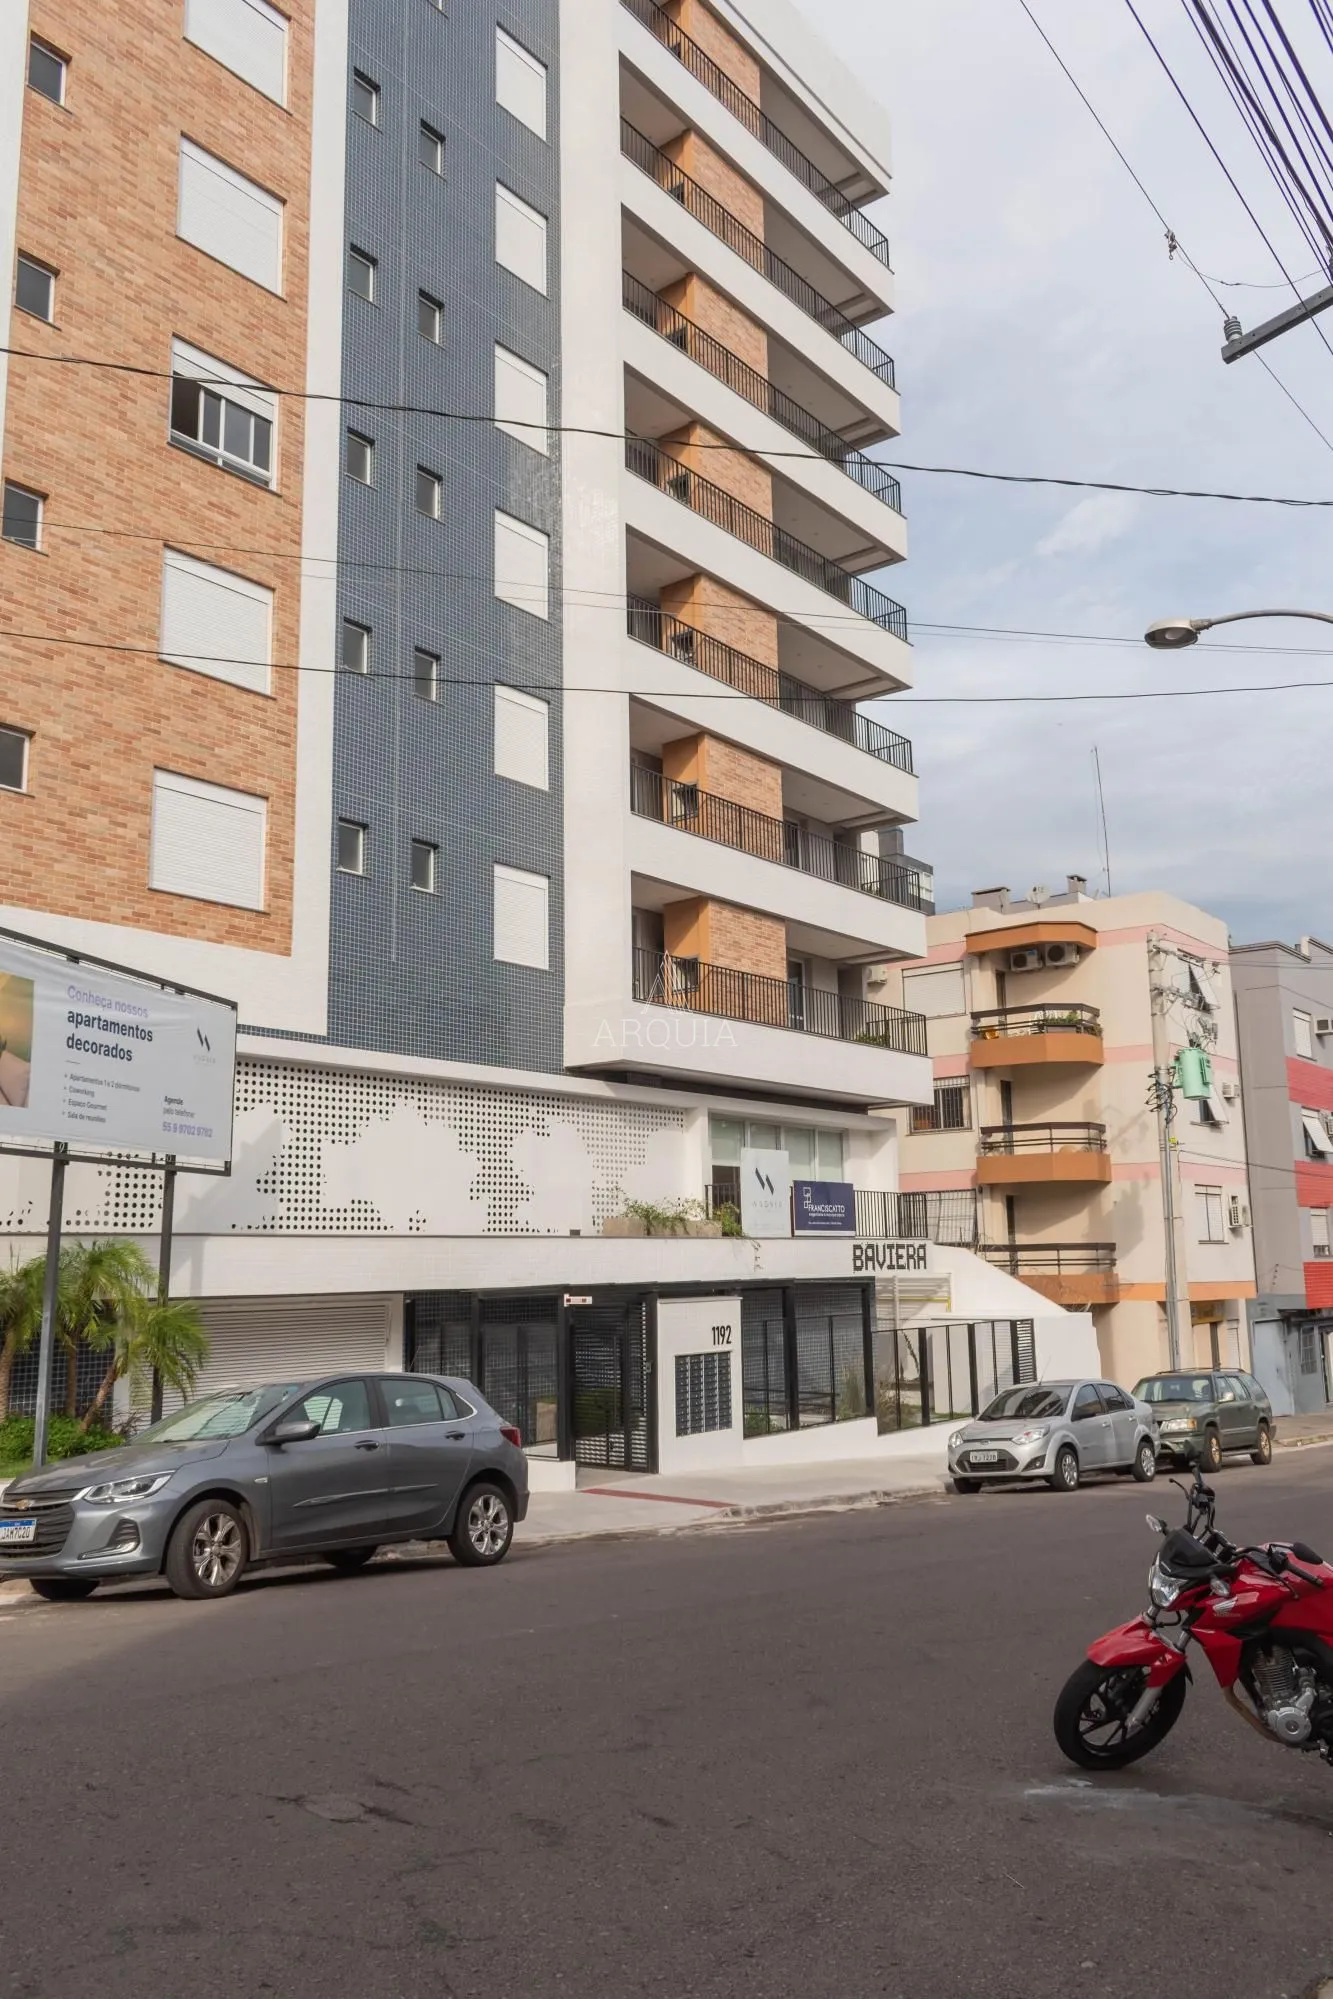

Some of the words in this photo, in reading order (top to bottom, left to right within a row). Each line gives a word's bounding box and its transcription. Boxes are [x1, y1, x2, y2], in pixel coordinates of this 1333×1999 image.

[67, 985, 112, 1010] Conheça
[115, 1001, 149, 1018] nossos
[67, 1010, 153, 1042] apartamentos
[66, 1032, 133, 1062] decorados
[808, 1204, 846, 1213] FRANCISCATTO
[853, 1243, 927, 1271] BAVIERA
[712, 1325, 732, 1346] 1192
